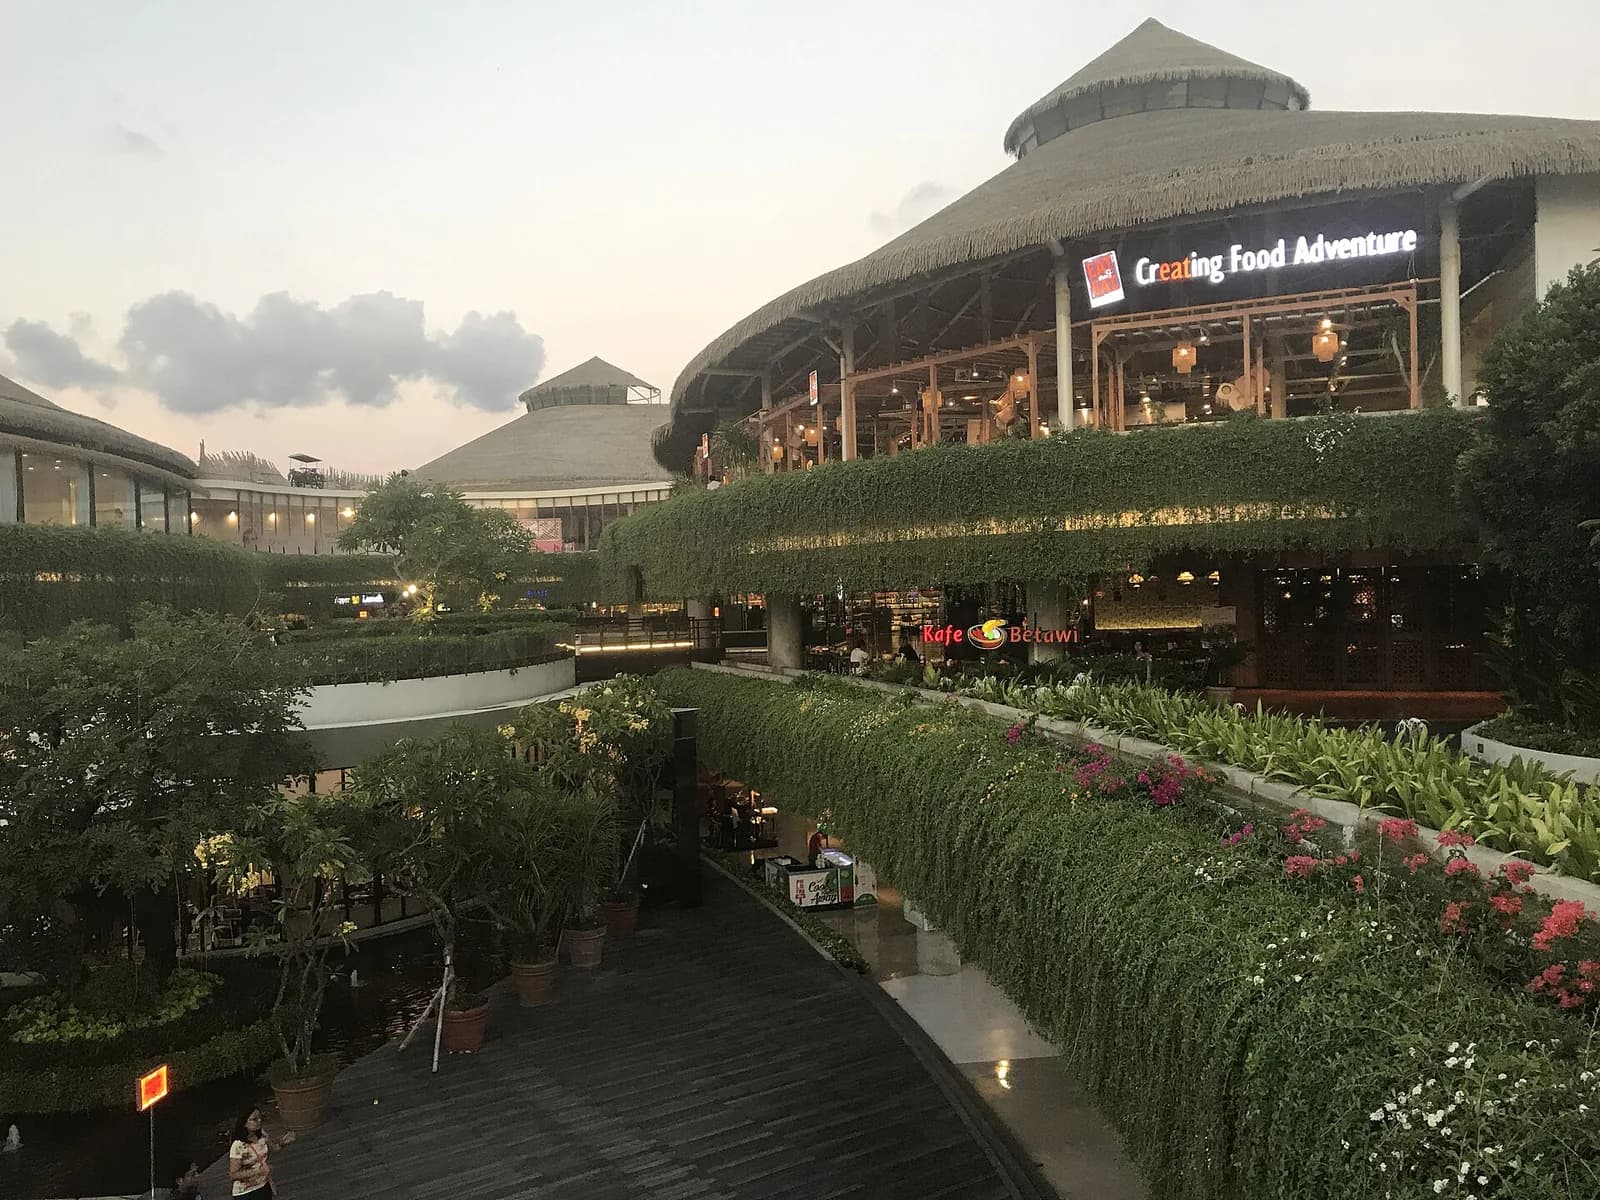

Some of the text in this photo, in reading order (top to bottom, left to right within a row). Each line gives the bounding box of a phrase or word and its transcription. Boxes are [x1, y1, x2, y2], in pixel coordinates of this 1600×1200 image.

[1136, 230, 1417, 284] Creating Food Adventure
[923, 624, 1079, 646] Kafe Betawi
